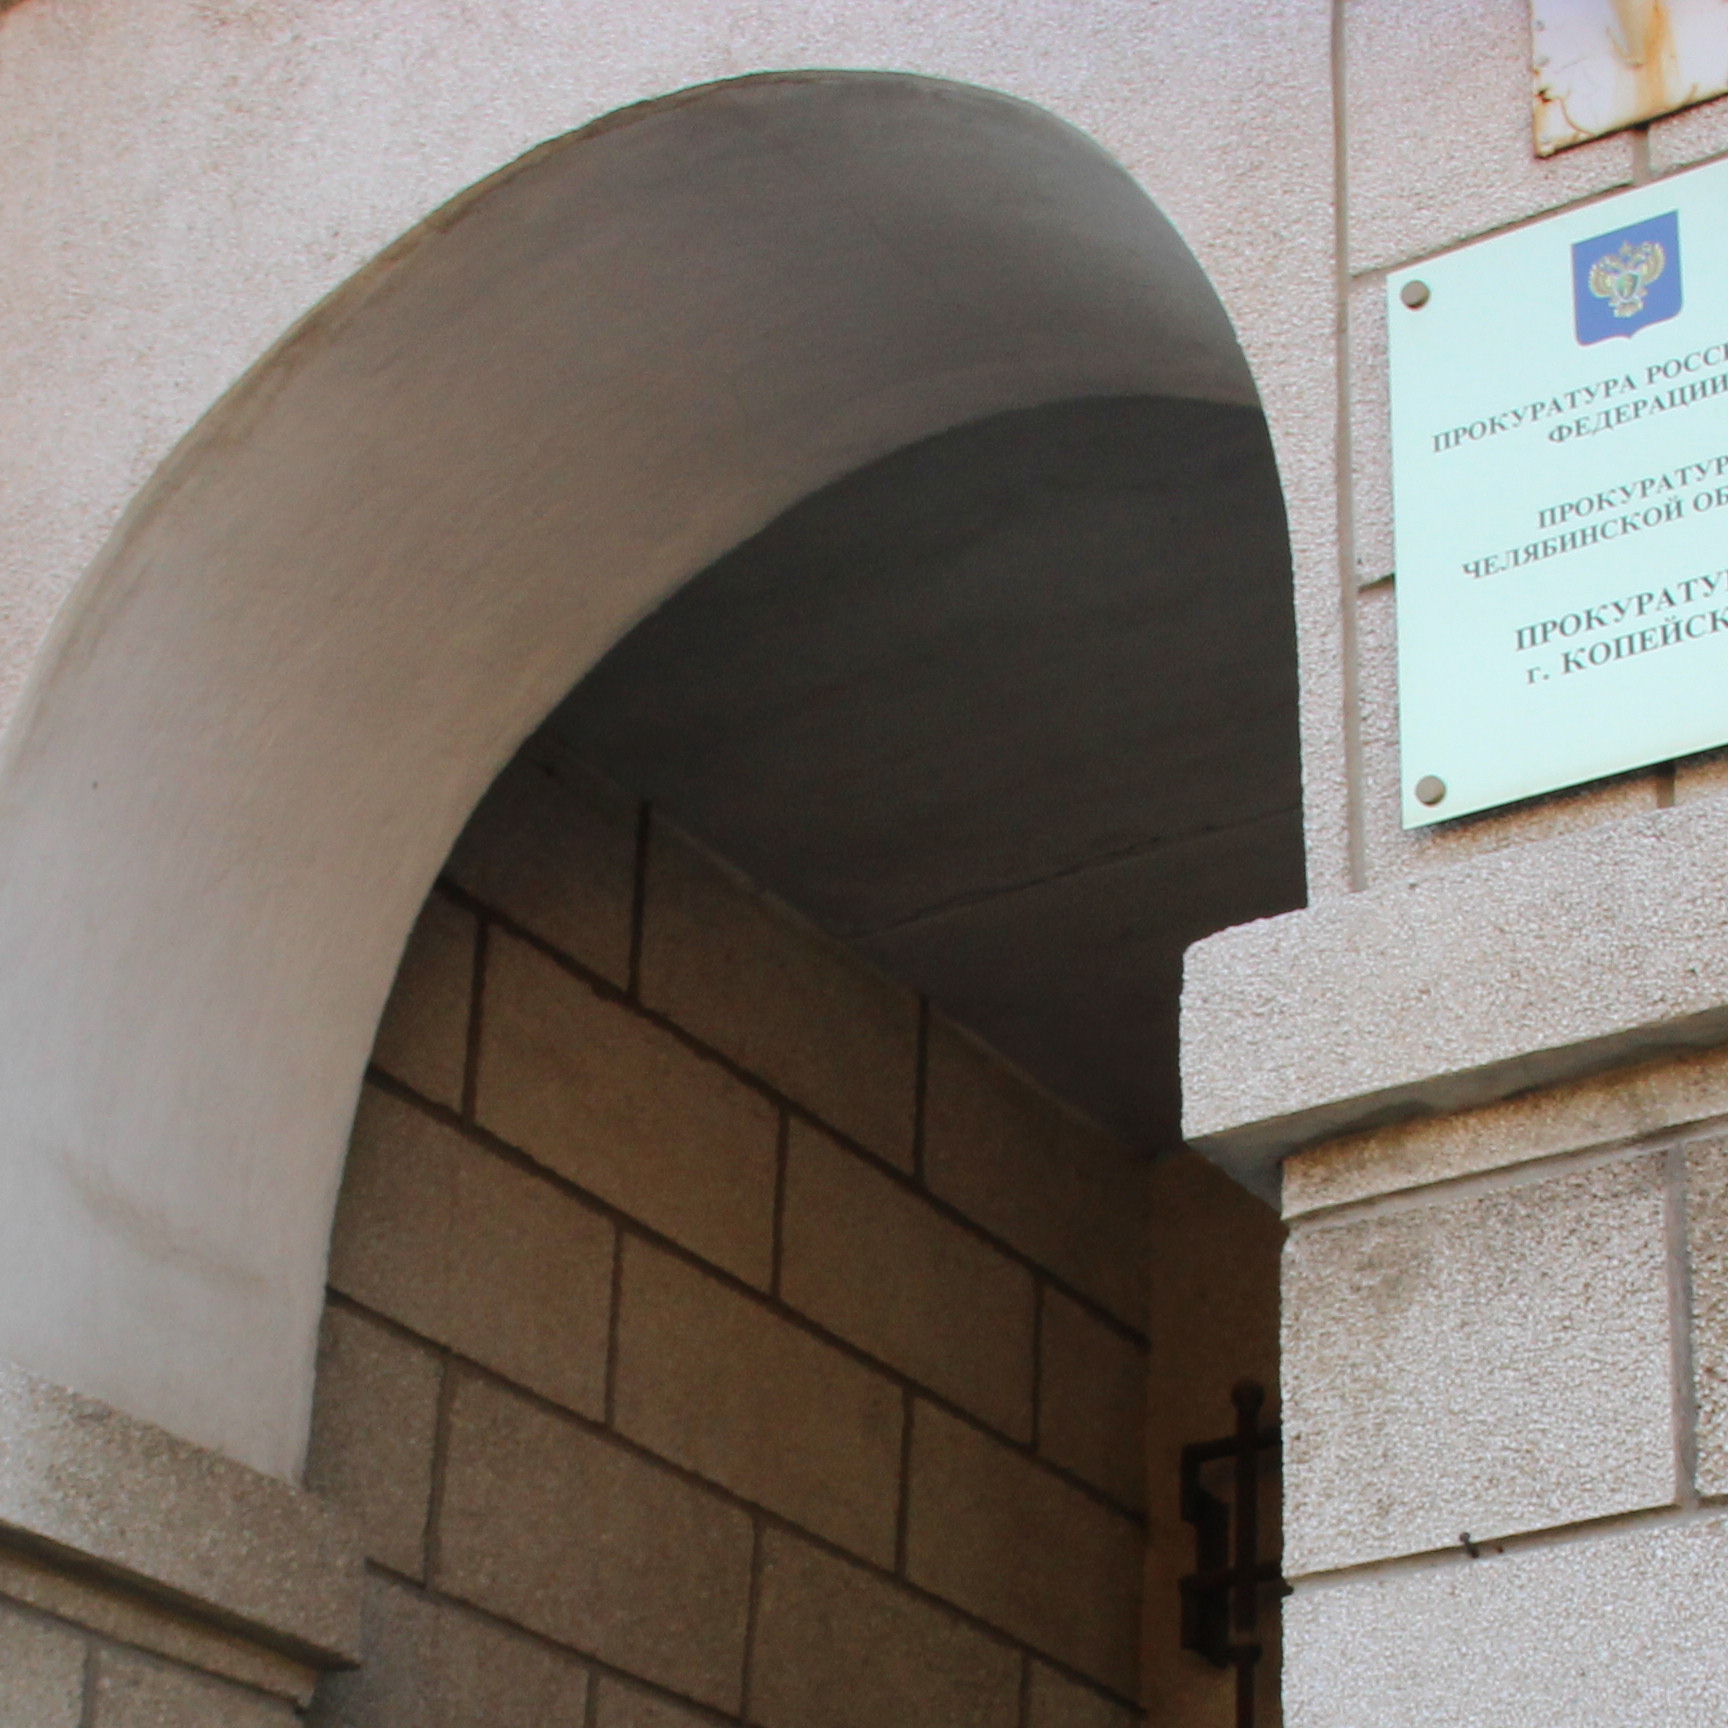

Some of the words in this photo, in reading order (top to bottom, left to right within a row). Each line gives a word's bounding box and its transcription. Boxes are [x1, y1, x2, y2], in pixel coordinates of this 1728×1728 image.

[1431, 373, 1637, 453] ПРОКУРАТУРА
[1461, 497, 1685, 580] ЧЕЛЯБИНСКОЙ
[1526, 666, 1551, 685] г.
